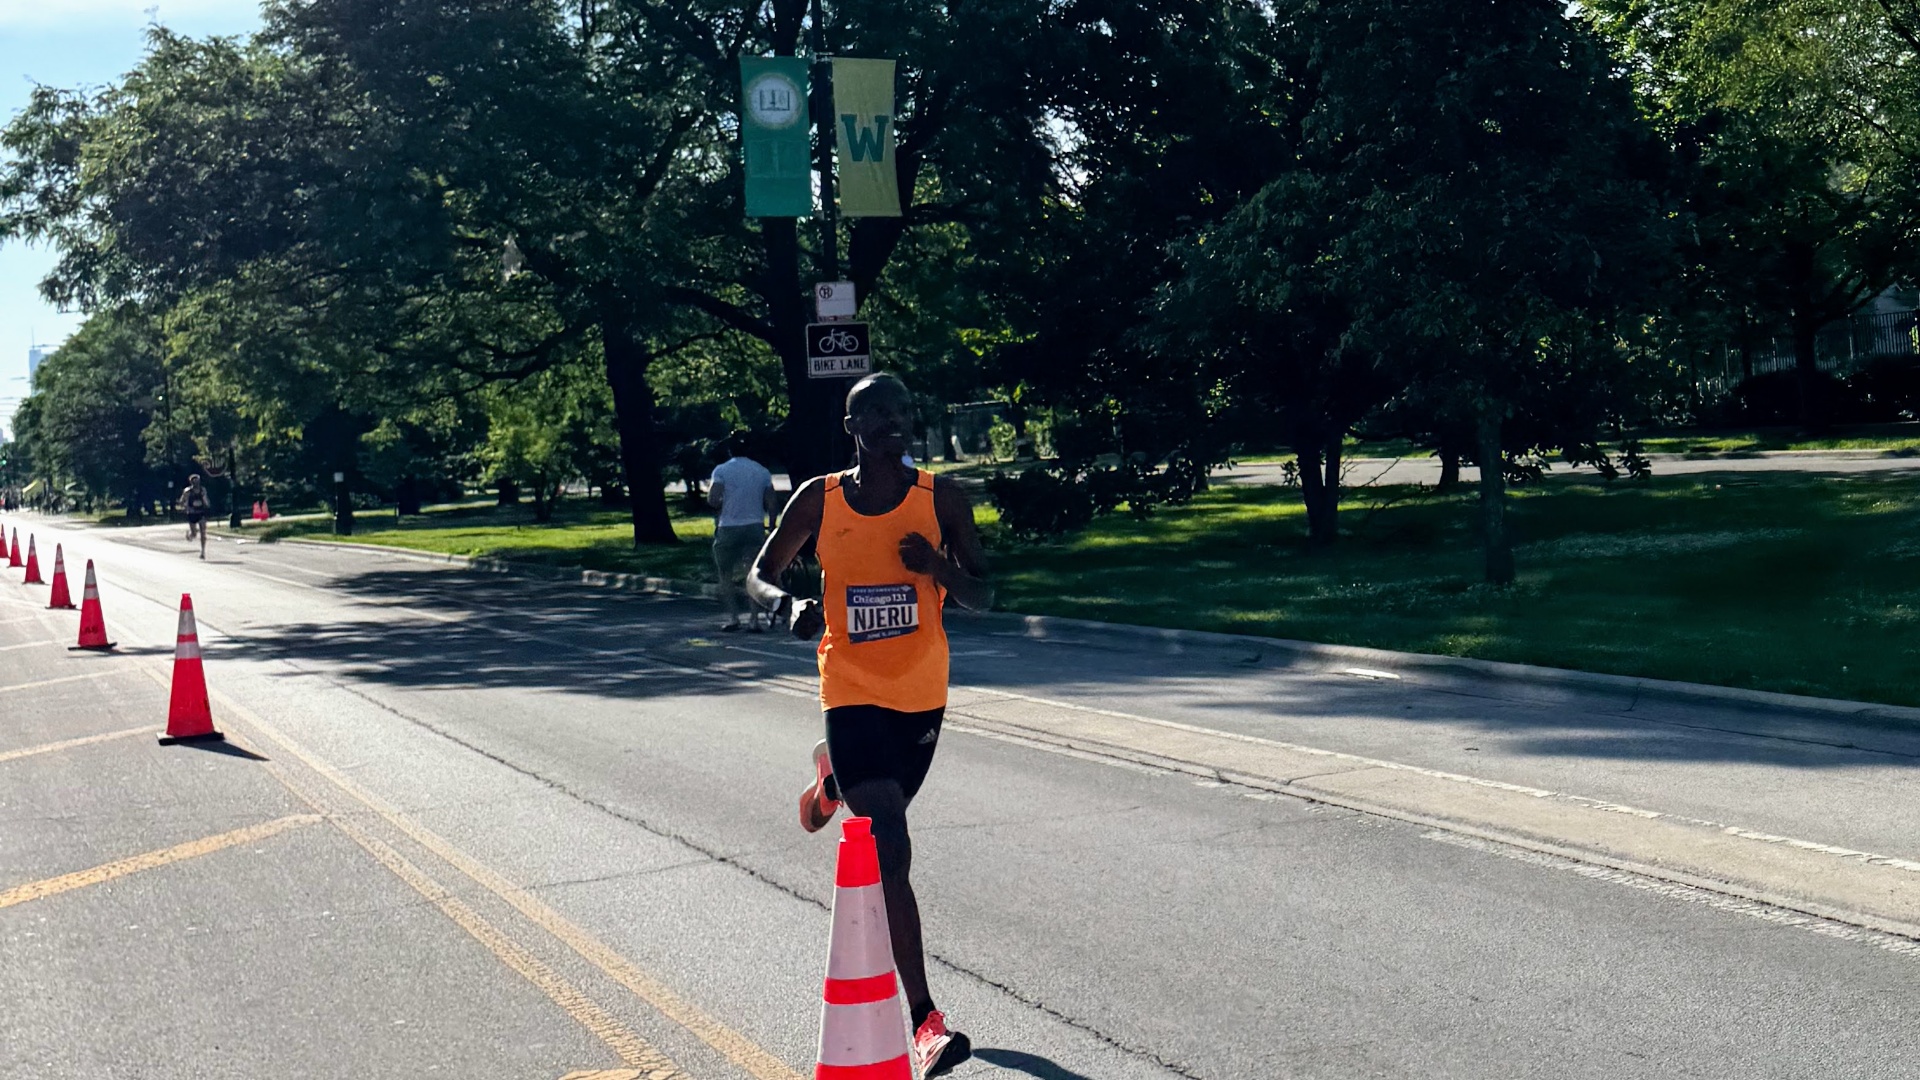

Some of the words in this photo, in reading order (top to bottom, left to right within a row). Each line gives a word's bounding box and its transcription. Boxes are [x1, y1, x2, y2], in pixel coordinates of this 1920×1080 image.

[841, 113, 890, 162] W
[813, 360, 836, 372] BIKE
[840, 358, 865, 371] LANE
[853, 595, 892, 605] Chicago
[892, 593, 907, 602] 13.1
[854, 605, 913, 632] NJERU
